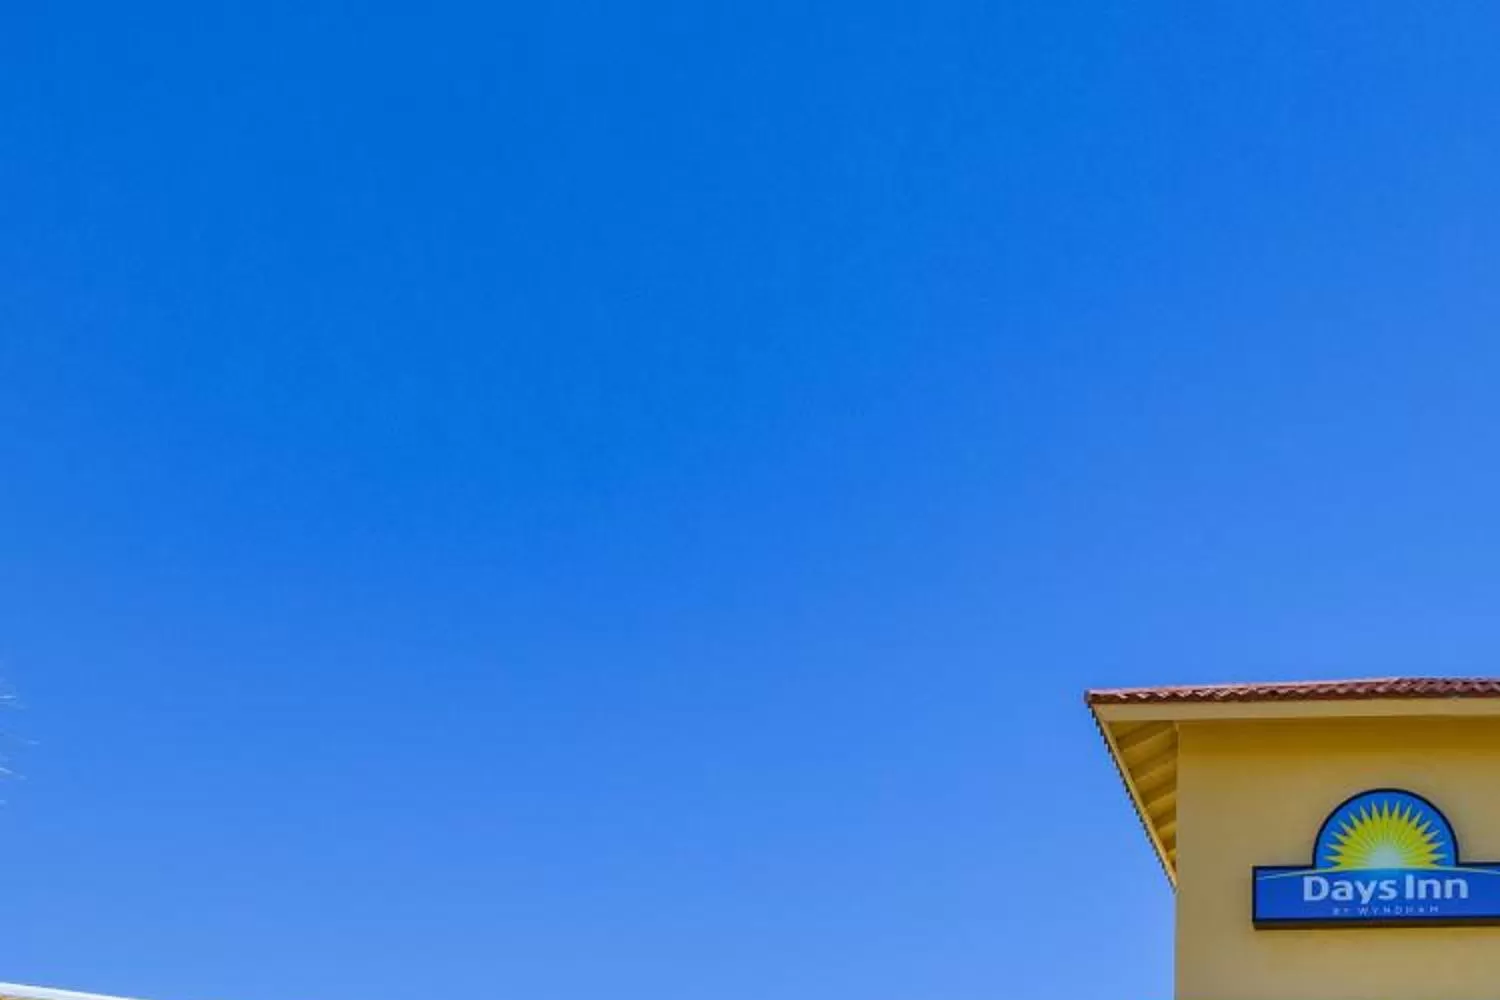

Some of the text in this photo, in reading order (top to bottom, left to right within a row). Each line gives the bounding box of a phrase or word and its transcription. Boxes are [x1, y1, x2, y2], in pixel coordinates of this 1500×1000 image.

[1303, 874, 1469, 904] Days Inn
[1359, 904, 1439, 916] WYNDHAM
